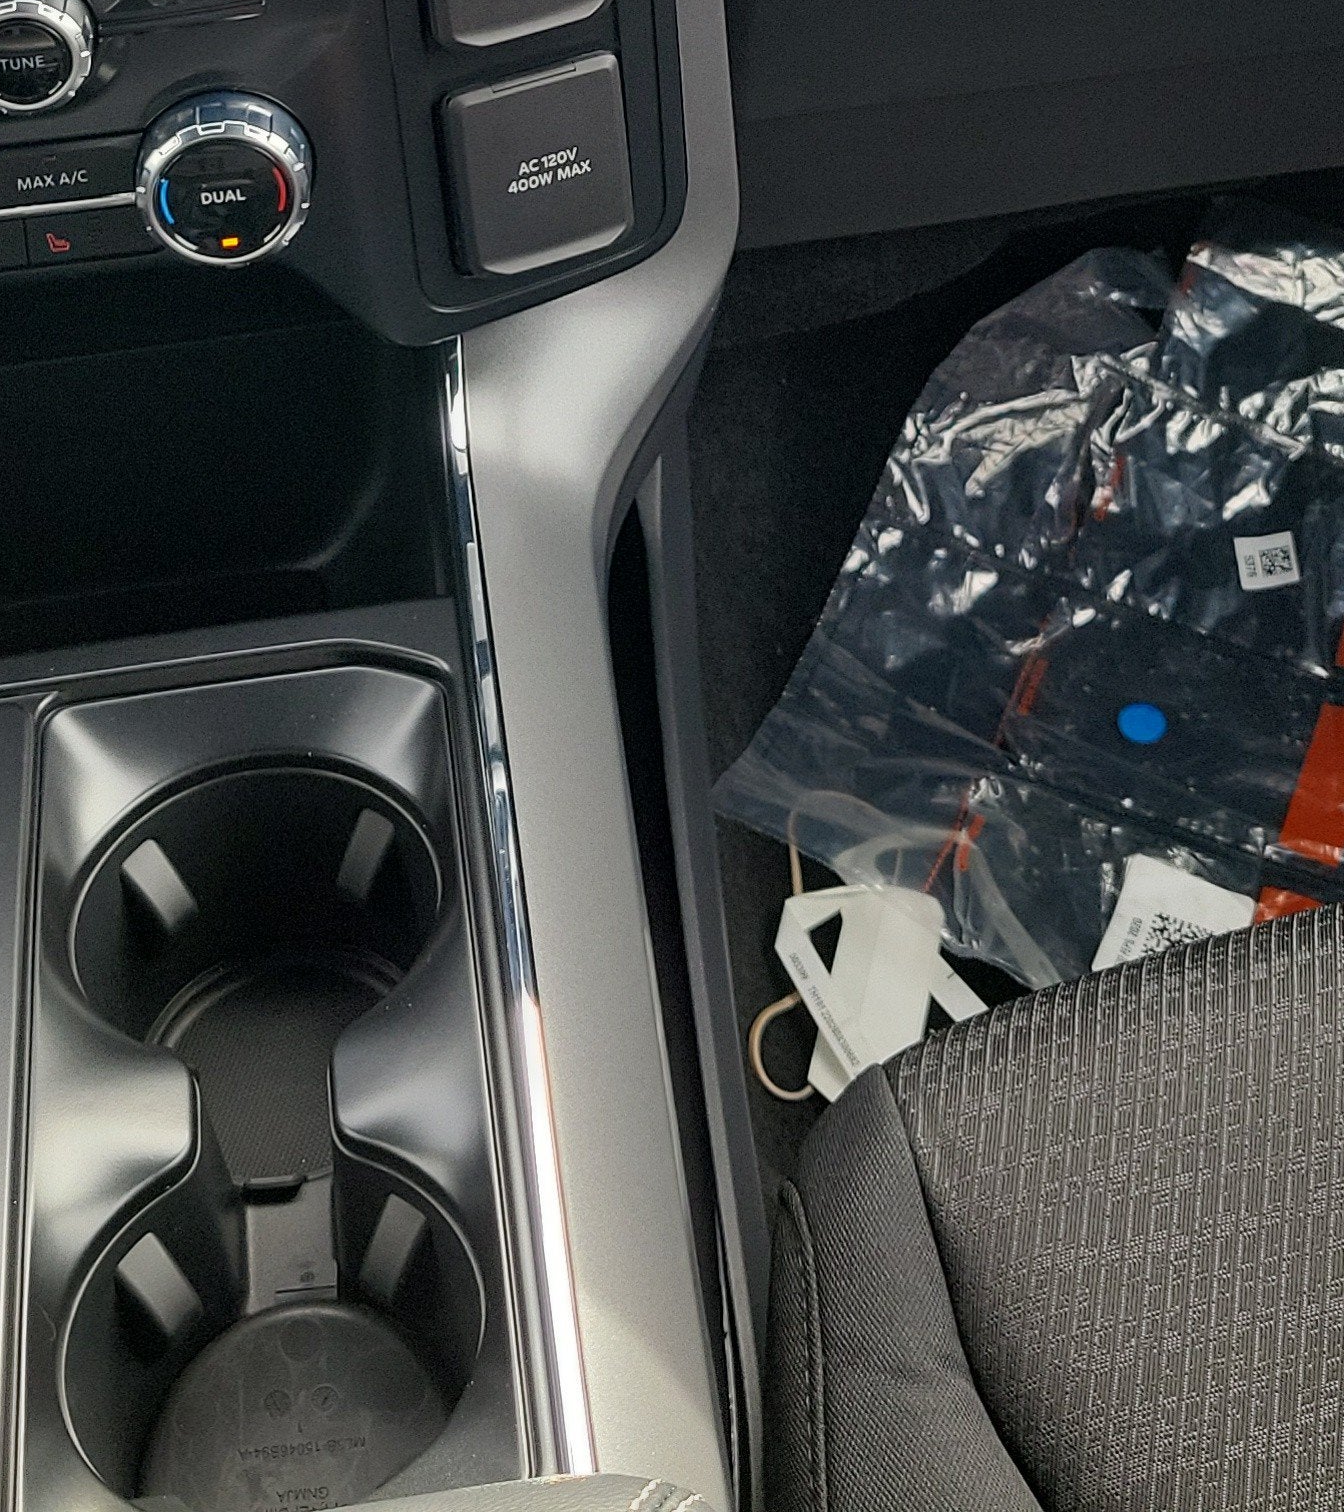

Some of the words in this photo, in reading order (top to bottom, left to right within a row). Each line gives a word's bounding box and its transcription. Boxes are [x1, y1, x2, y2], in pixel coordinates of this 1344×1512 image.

[0, 55, 46, 71] TUNE
[518, 157, 541, 176] AC
[541, 146, 578, 170] 120V
[17, 173, 54, 191] MAX
[59, 169, 89, 186] A/C
[508, 171, 554, 194] 400W
[557, 159, 592, 182] MAX
[200, 188, 246, 206] DUAL
